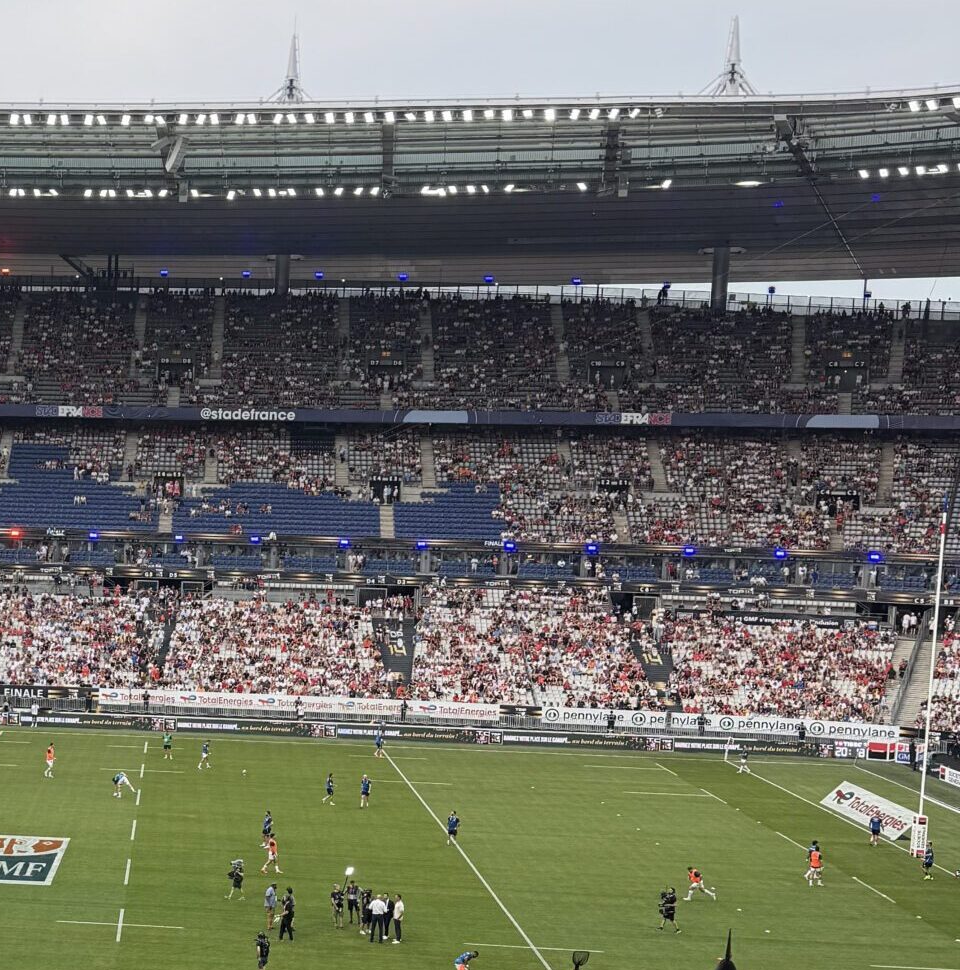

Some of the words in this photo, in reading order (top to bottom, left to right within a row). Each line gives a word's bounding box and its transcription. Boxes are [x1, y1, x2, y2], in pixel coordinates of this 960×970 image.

[35, 405, 103, 418] STADEFRANCE
[200, 408, 296, 421] @stadefrance
[595, 412, 672, 425] STADEFRANCE
[3, 688, 44, 698] FINALE
[198, 696, 253, 707] TotalEnergies
[439, 706, 497, 717] TotalEnergies
[563, 711, 624, 723] pennylae
[829, 725, 895, 738] pennylane
